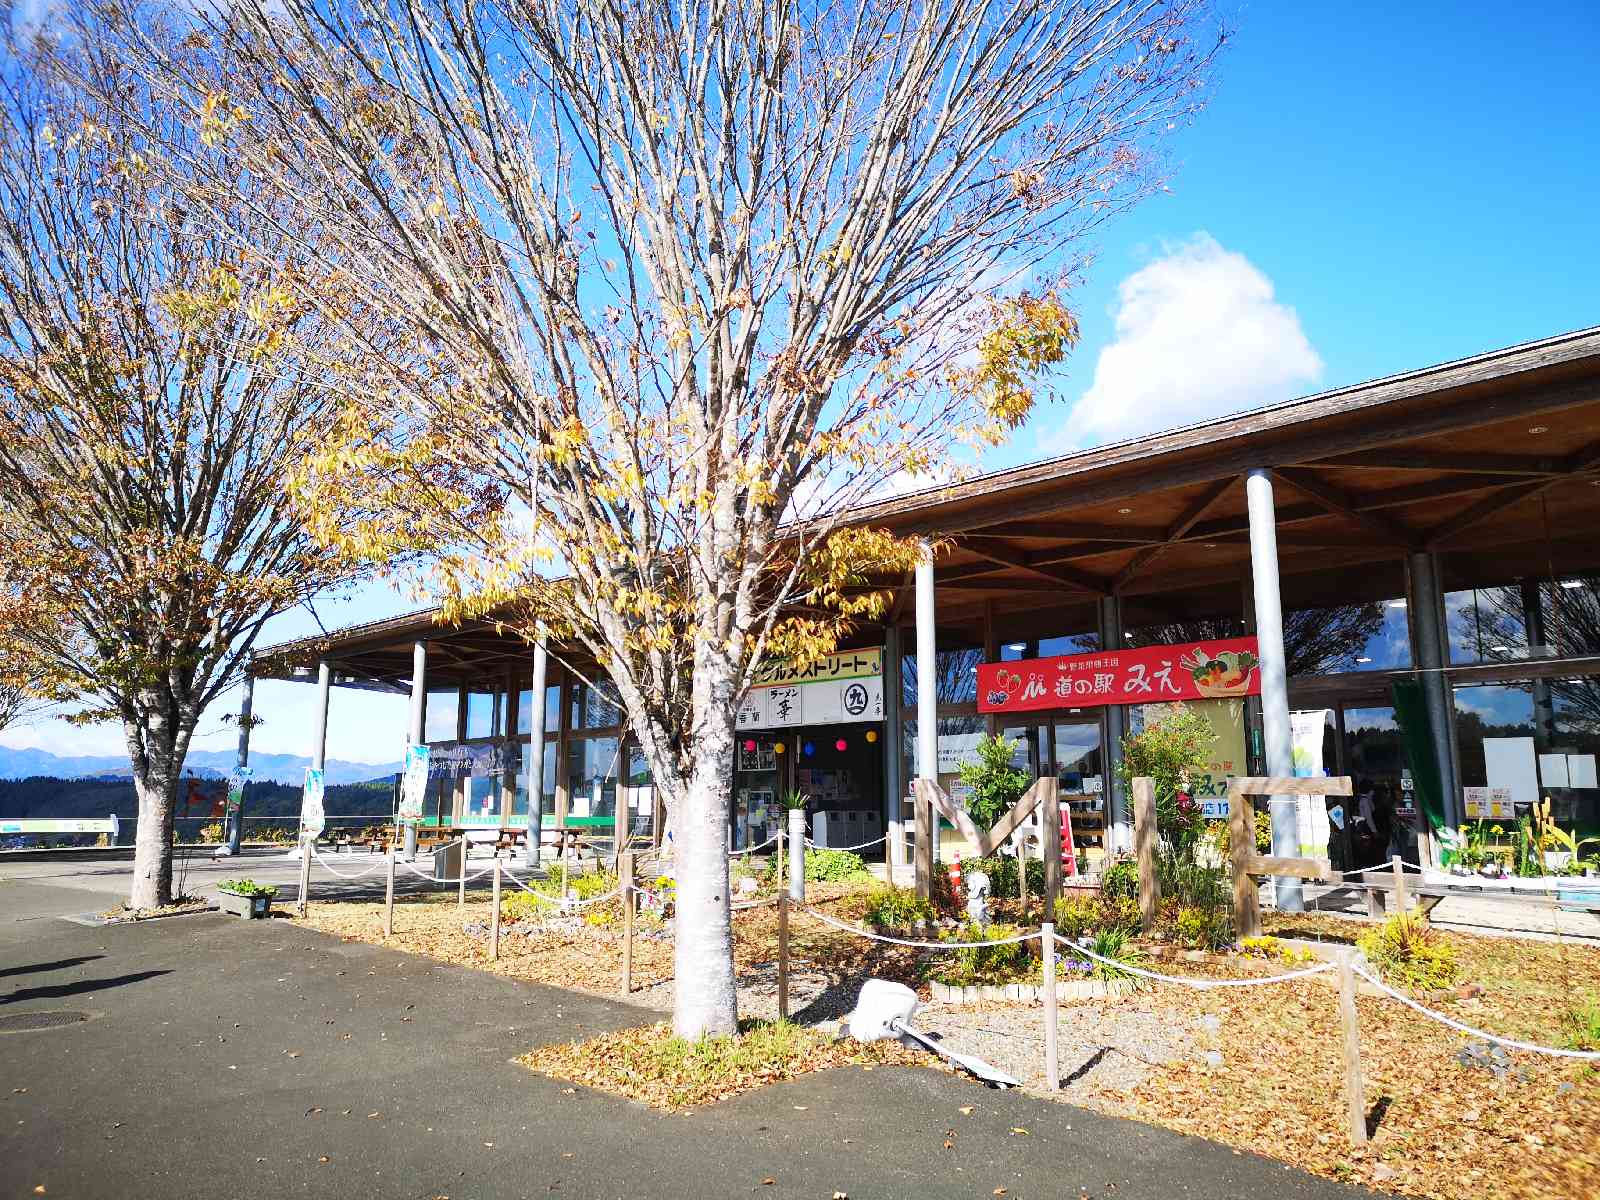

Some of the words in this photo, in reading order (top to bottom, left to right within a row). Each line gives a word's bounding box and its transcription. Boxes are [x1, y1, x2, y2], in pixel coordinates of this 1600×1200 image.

[1054, 673, 1115, 698] 道の駅
[1123, 660, 1182, 694] みえ
[770, 687, 799, 699] ラーメン
